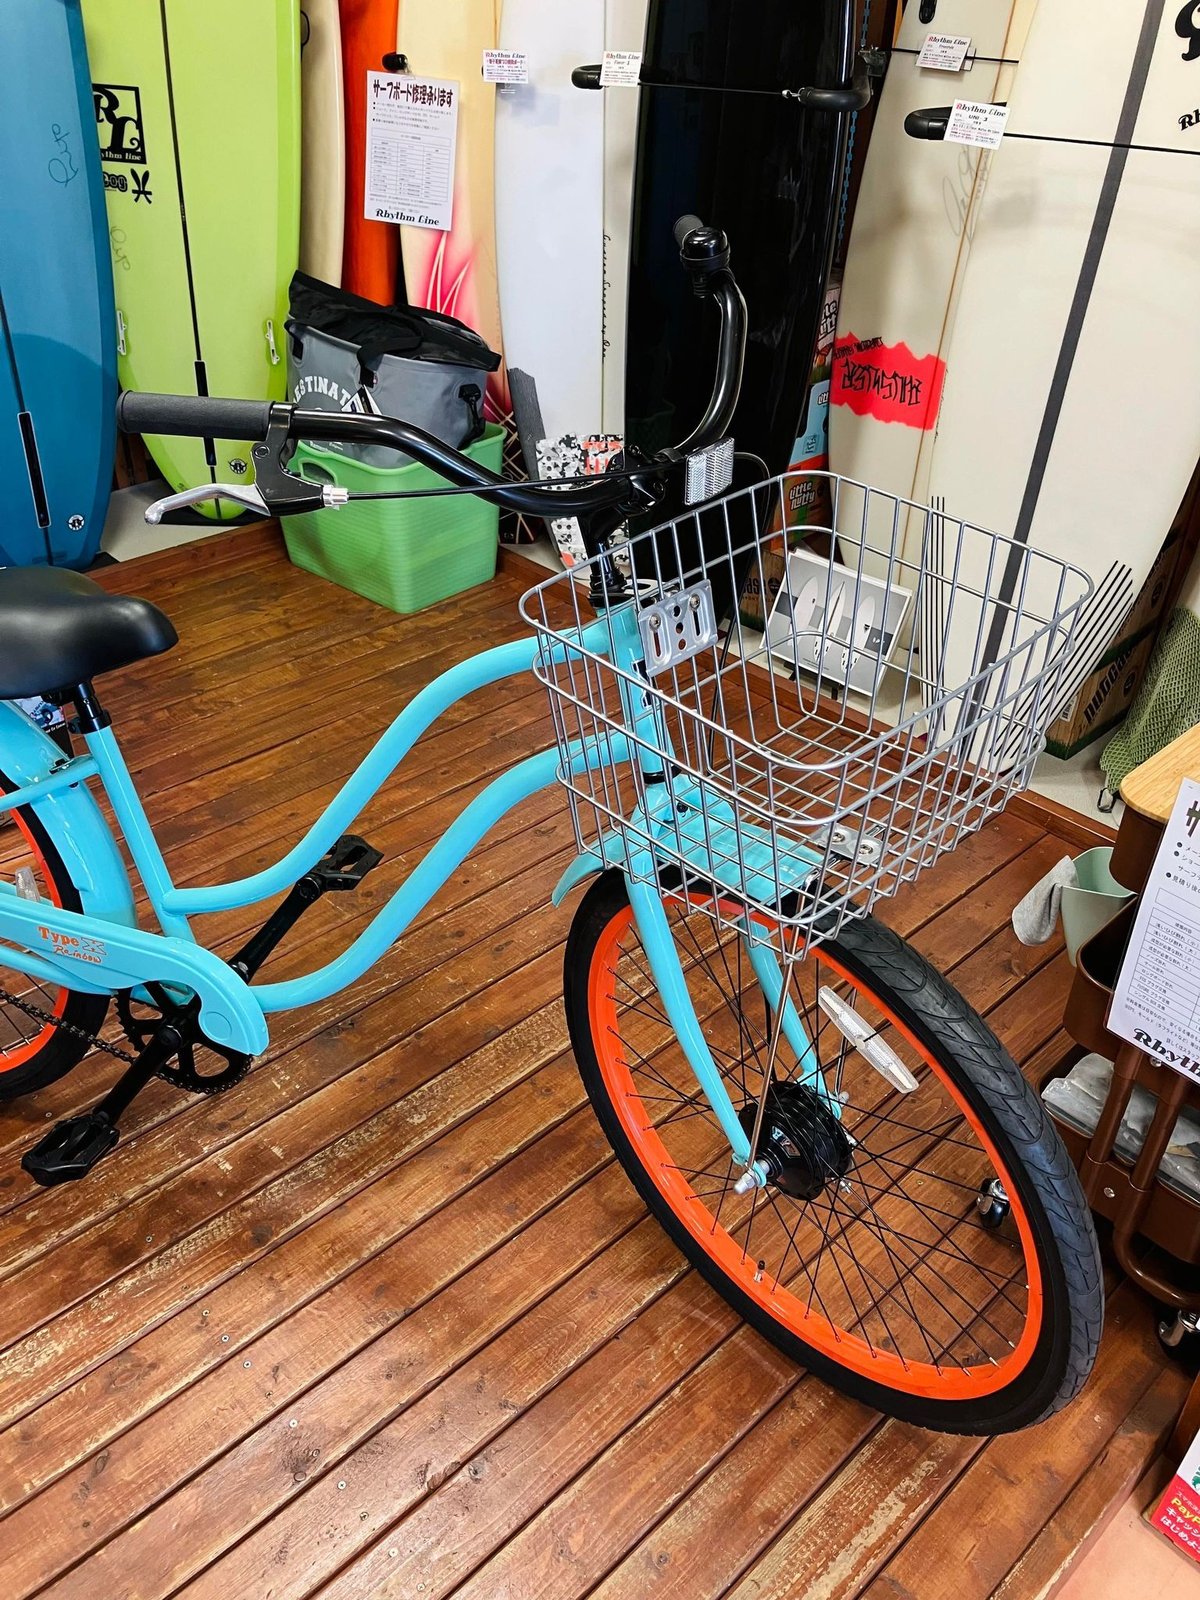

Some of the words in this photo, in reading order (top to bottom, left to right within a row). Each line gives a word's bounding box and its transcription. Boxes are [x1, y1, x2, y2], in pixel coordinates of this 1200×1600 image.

[373, 79, 454, 108] サーフボード修理承ります
[375, 208, 415, 223] Rhythm
[293, 375, 351, 406] ESTINAT
[38, 926, 80, 946] Type
[53, 945, 102, 964] Rainbow
